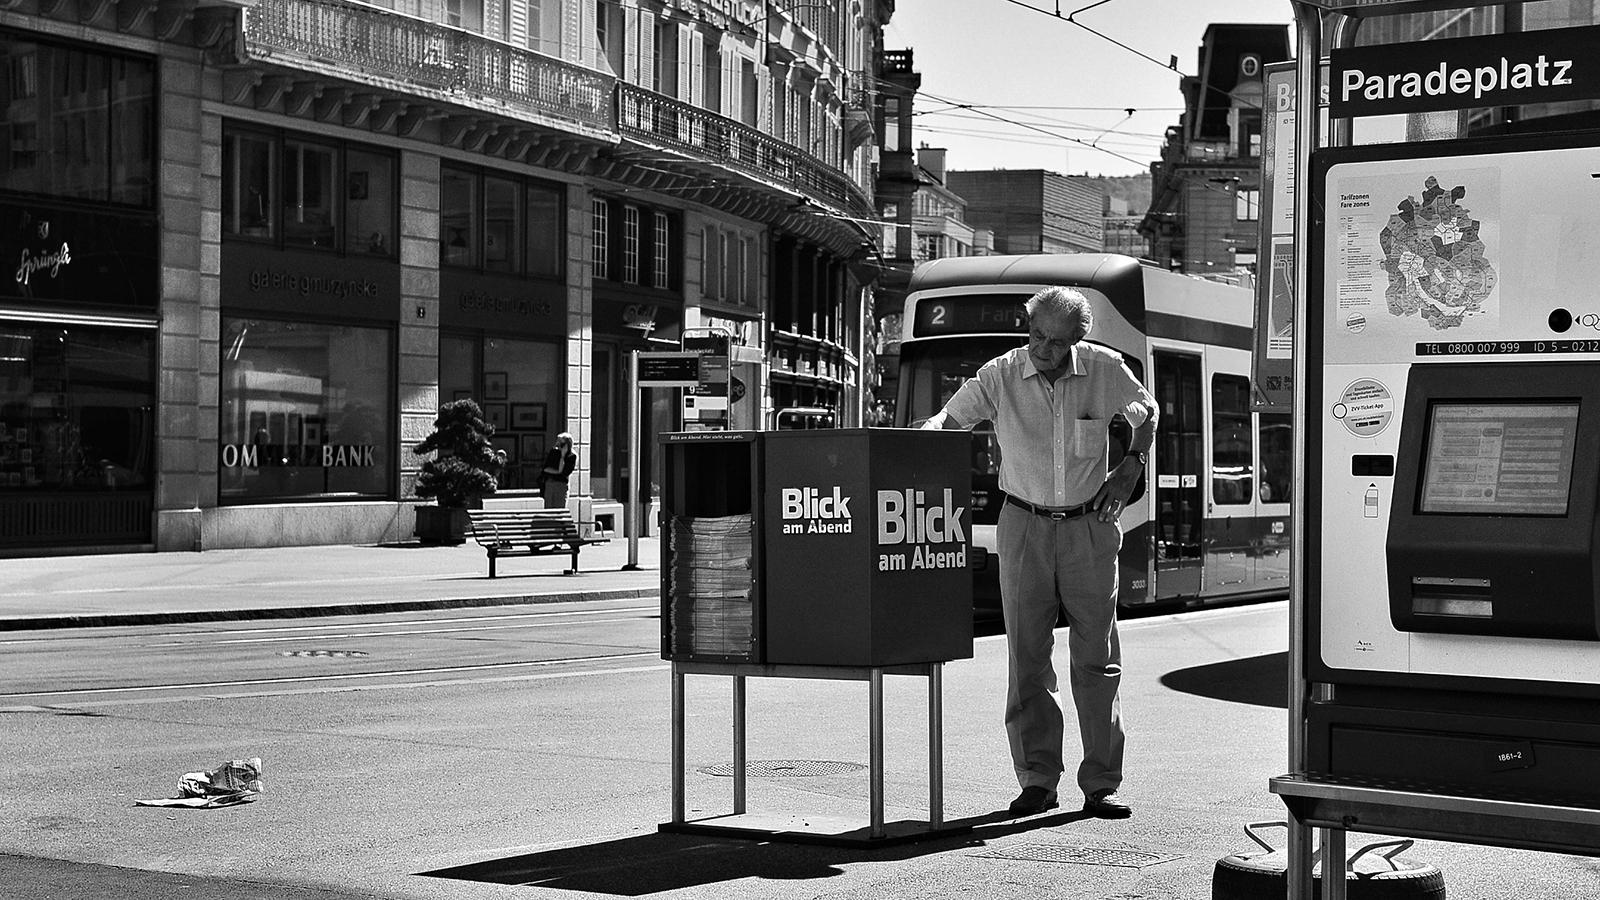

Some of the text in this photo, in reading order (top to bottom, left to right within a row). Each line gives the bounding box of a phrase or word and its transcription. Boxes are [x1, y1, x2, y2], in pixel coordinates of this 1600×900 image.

[1341, 54, 1573, 102] Paradeplatz
[249, 267, 297, 292] galerie
[931, 303, 1026, 325] 2 Farb
[1425, 343, 1443, 354] TEL
[1448, 343, 1475, 353] 0800
[1477, 342, 1497, 353] 007
[1500, 342, 1520, 353] 999
[1533, 341, 1546, 352] ID
[1551, 341, 1558, 352] 5
[1571, 340, 1599, 352] 0212
[689, 385, 695, 395] 9
[222, 443, 375, 468] OM BANK
[781, 486, 851, 519] Blick
[782, 519, 852, 534] am Abend
[877, 488, 966, 545] Blick
[878, 544, 967, 571] am Abend
[1498, 751, 1522, 761] 1861-2
